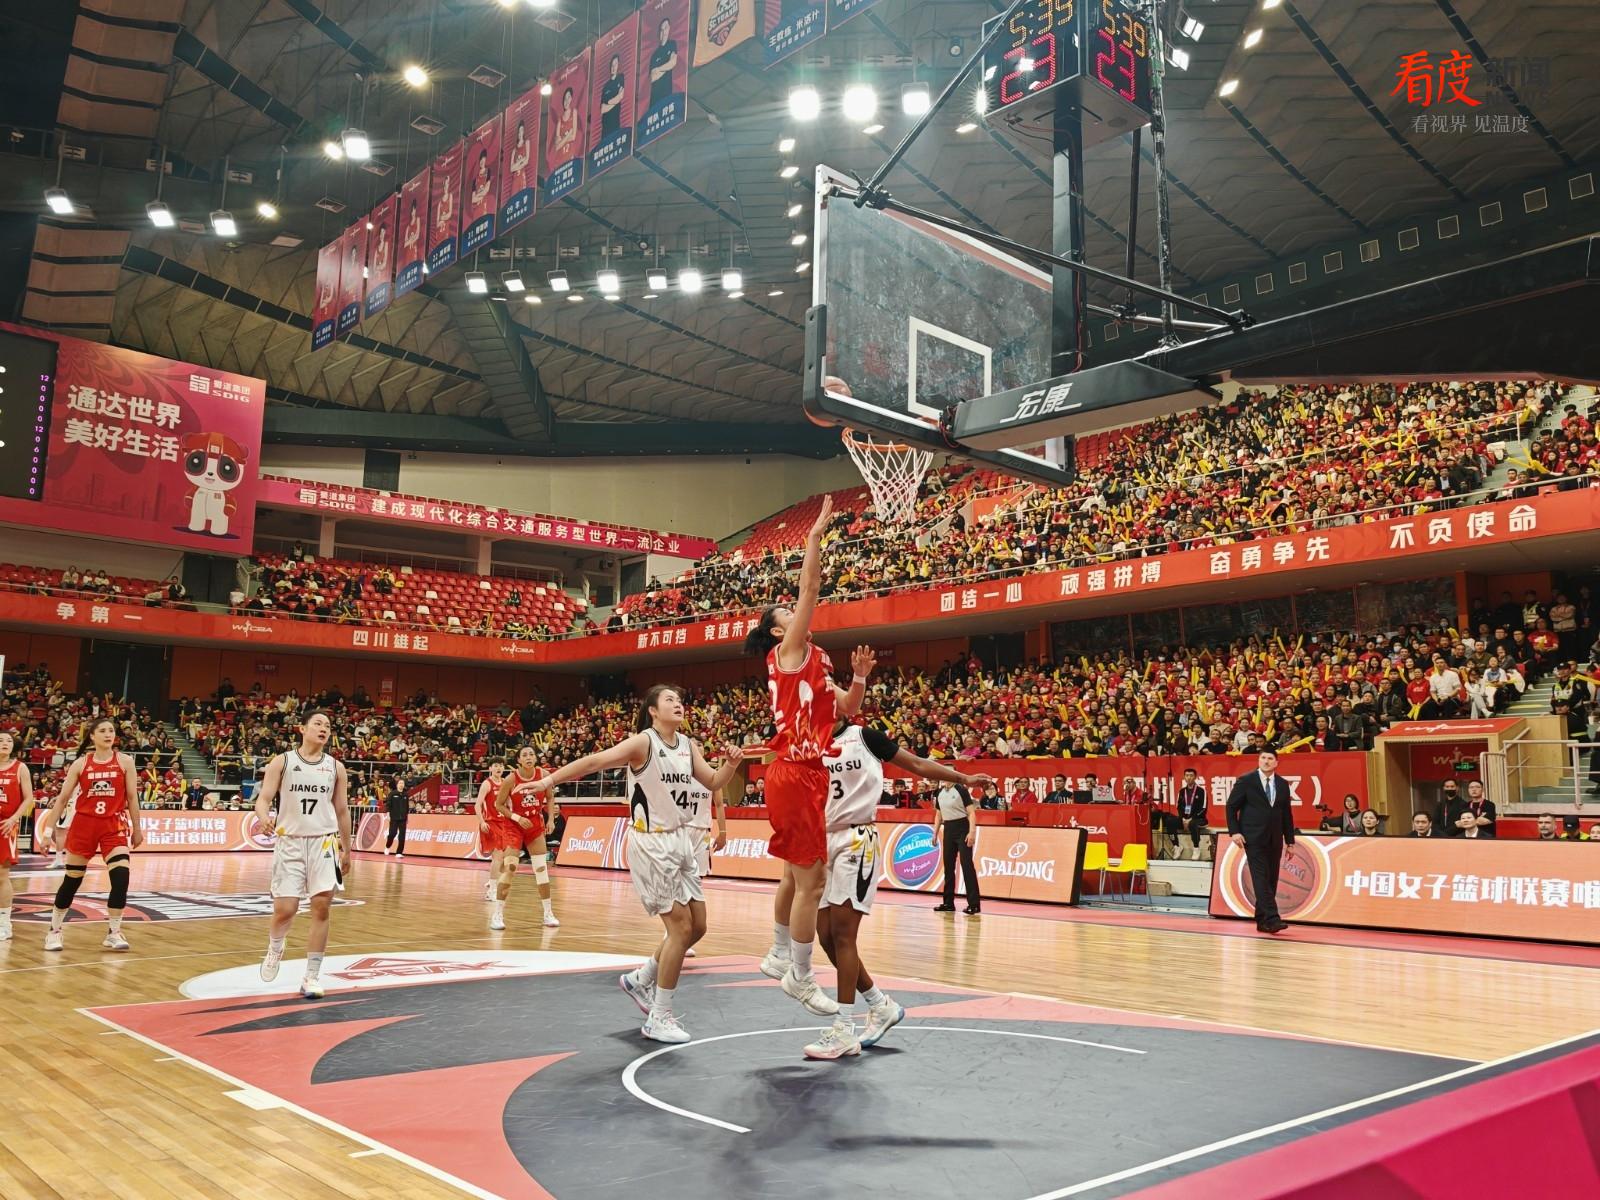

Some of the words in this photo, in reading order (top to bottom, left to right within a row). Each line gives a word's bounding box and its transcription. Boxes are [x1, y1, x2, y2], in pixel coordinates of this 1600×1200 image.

[1000, 32, 1056, 104] 23
[1097, 28, 1137, 102] 23
[41, 374, 49, 382] 12
[67, 384, 182, 430] 通达世界
[212, 390, 250, 403] SDIG
[63, 417, 180, 462] 美好生活
[319, 500, 356, 511] SDIG
[371, 497, 681, 554] 建成现代化综合交通服务型世界一流企业
[940, 582, 1023, 612] 团结一心
[1060, 560, 1162, 596] 顽强拼搏
[1210, 536, 1330, 576] 奋勇争先
[1389, 504, 1538, 550] 不负使命
[56, 602, 143, 624] 争第一
[353, 630, 429, 651] 四川雄起
[845, 760, 862, 771] SU
[289, 784, 318, 793] JIANG
[95, 801, 106, 815] 8
[300, 798, 318, 815] 17
[670, 789, 690, 810] 14
[979, 856, 1056, 883] SPALDING
